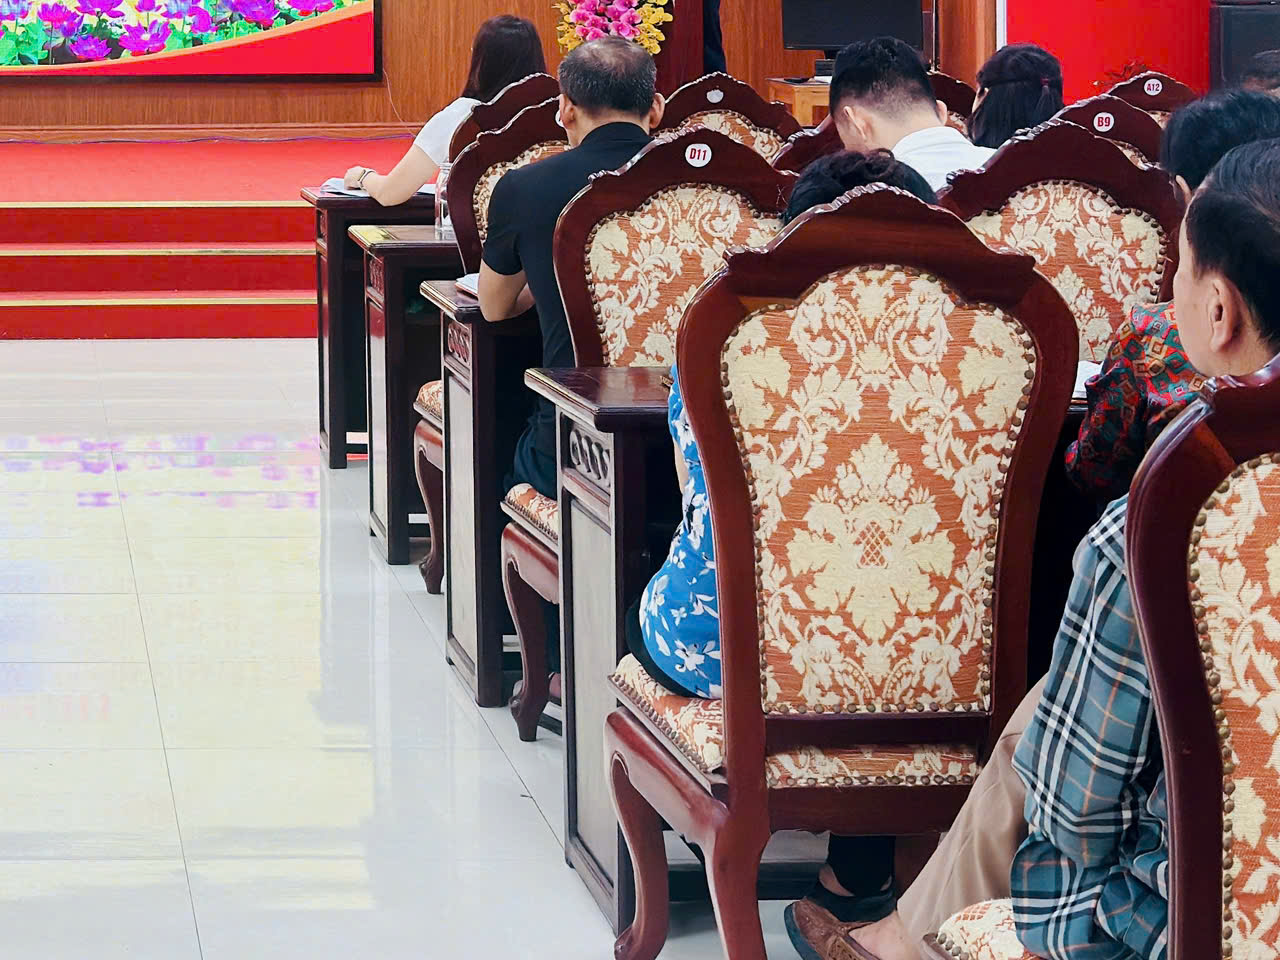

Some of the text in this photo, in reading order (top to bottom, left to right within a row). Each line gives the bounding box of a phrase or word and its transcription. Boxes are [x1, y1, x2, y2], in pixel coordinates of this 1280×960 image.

[1147, 84, 1160, 92] A12
[1097, 117, 1111, 127] B9
[690, 148, 707, 161] D11
